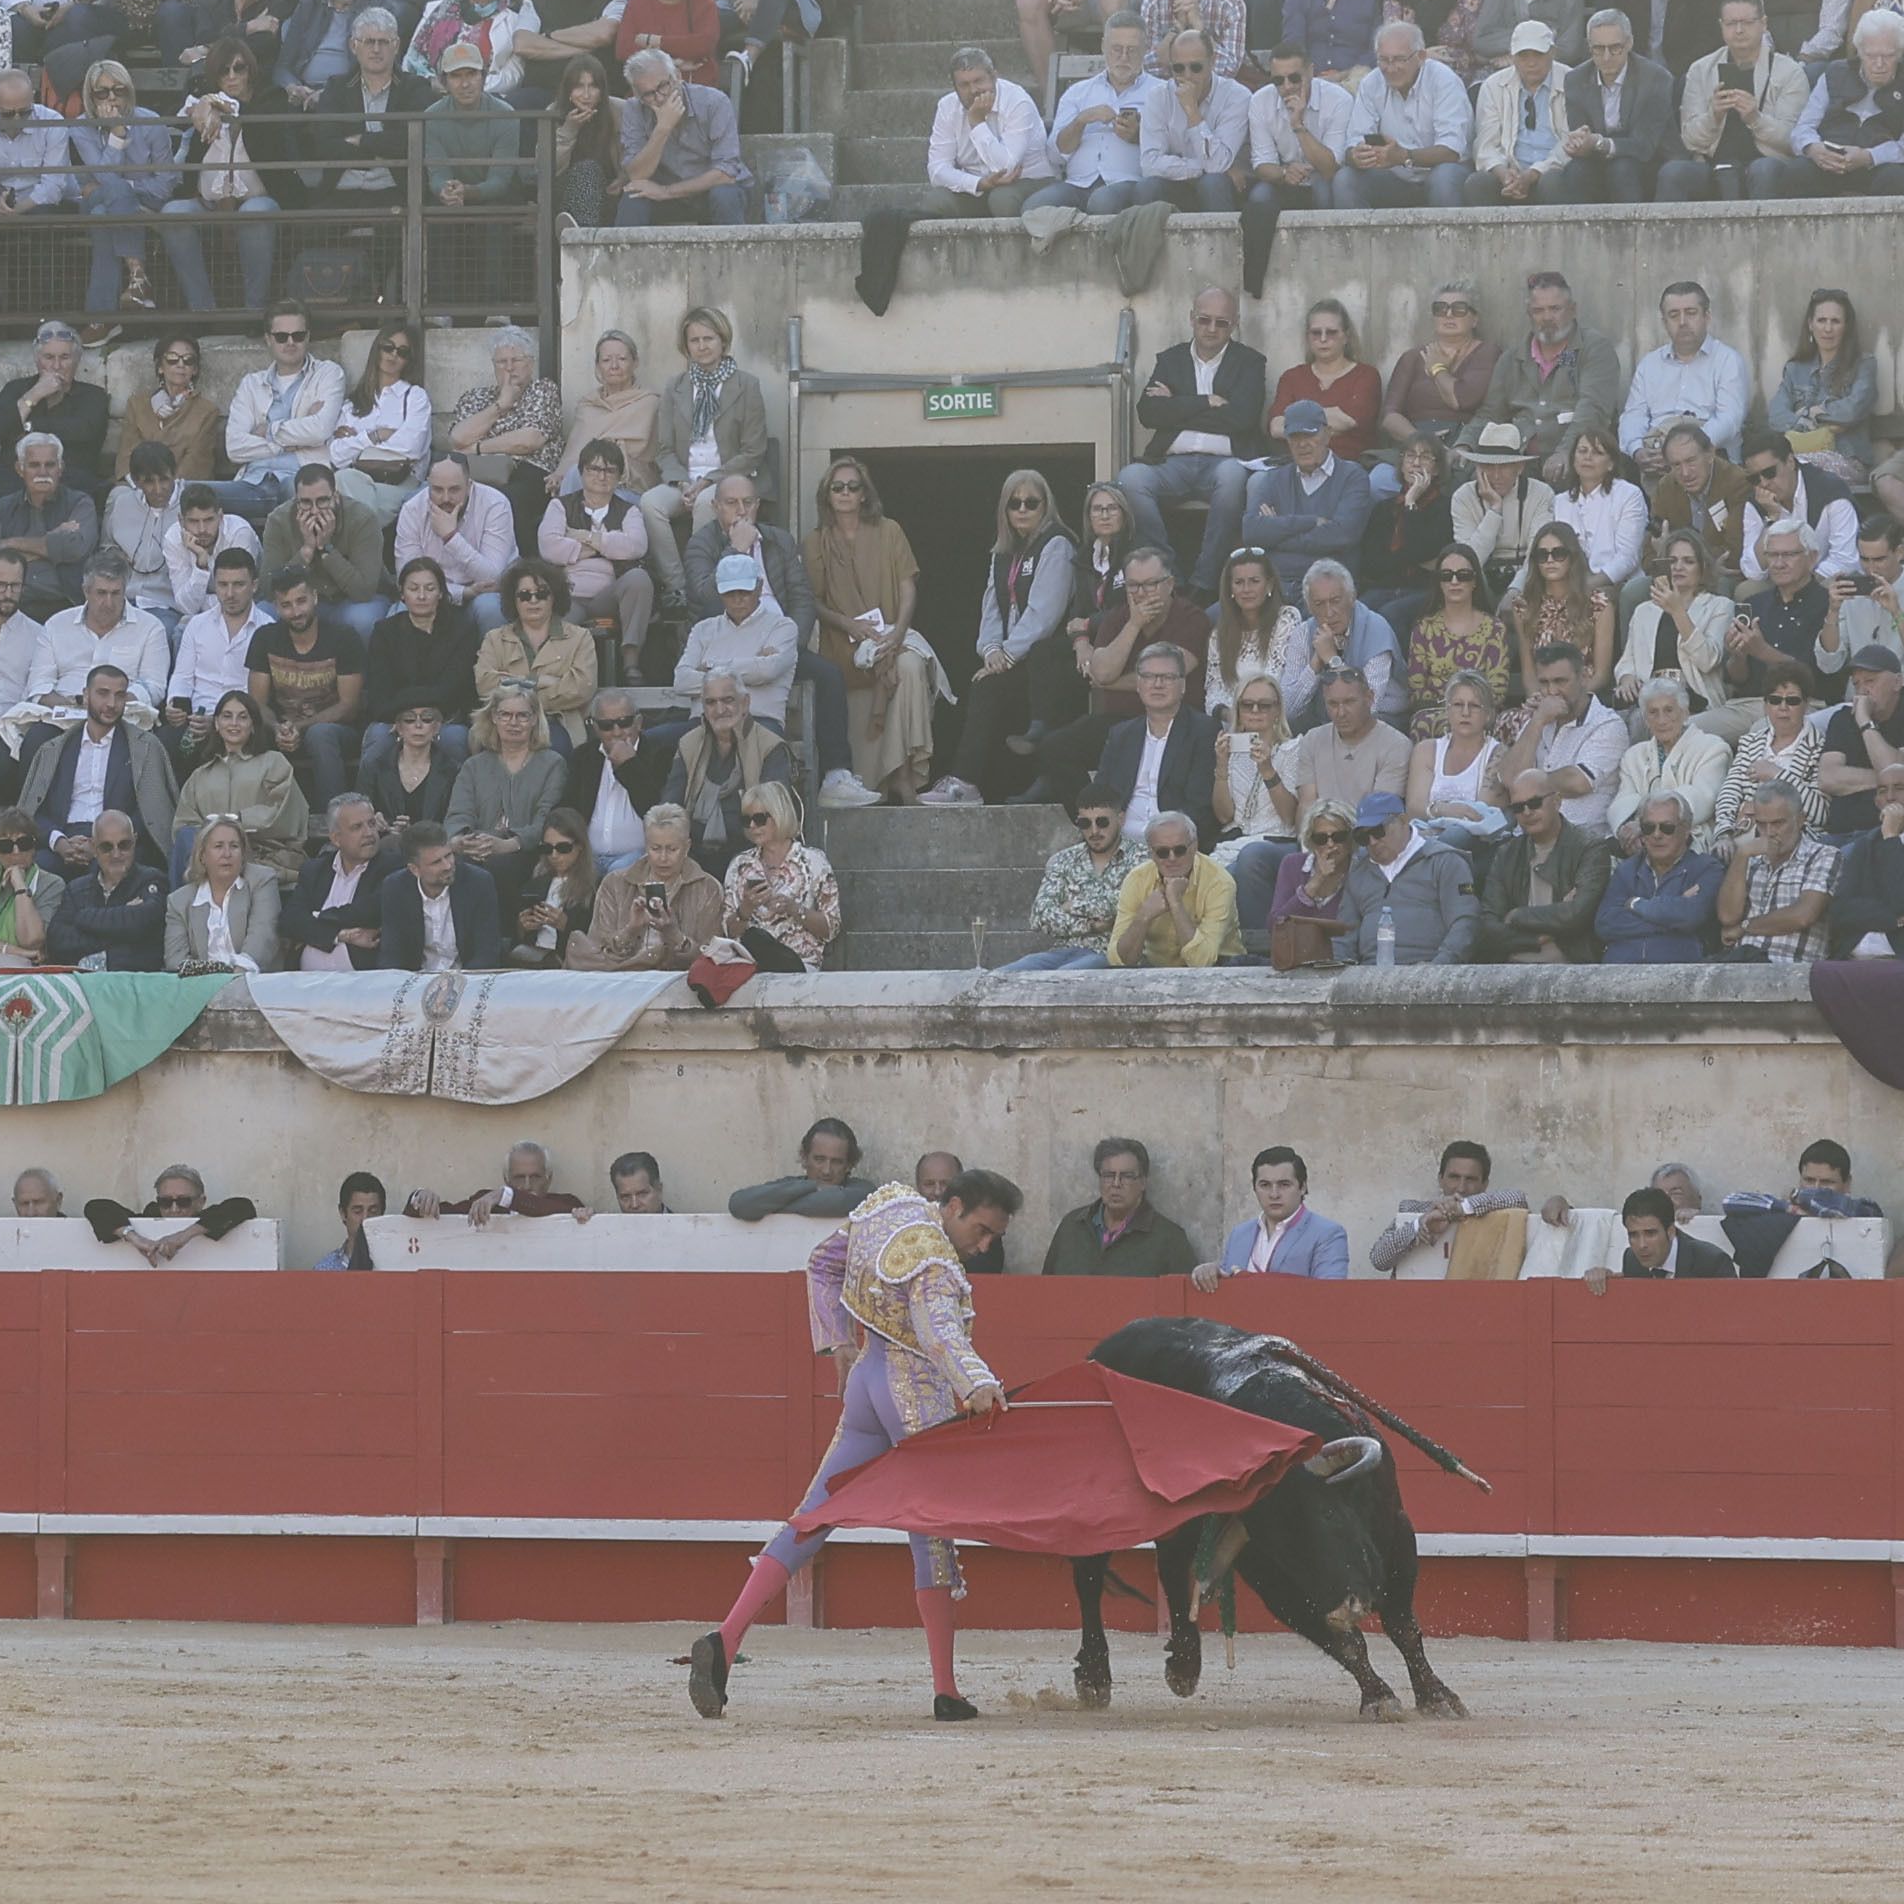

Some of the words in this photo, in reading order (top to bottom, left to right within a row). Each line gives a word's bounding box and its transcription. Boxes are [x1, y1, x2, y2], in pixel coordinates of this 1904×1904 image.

[928, 393, 994, 414] SORTIE
[1702, 1056, 1715, 1068] 10
[676, 1064, 685, 1077] 8
[408, 1236, 421, 1254] 8
